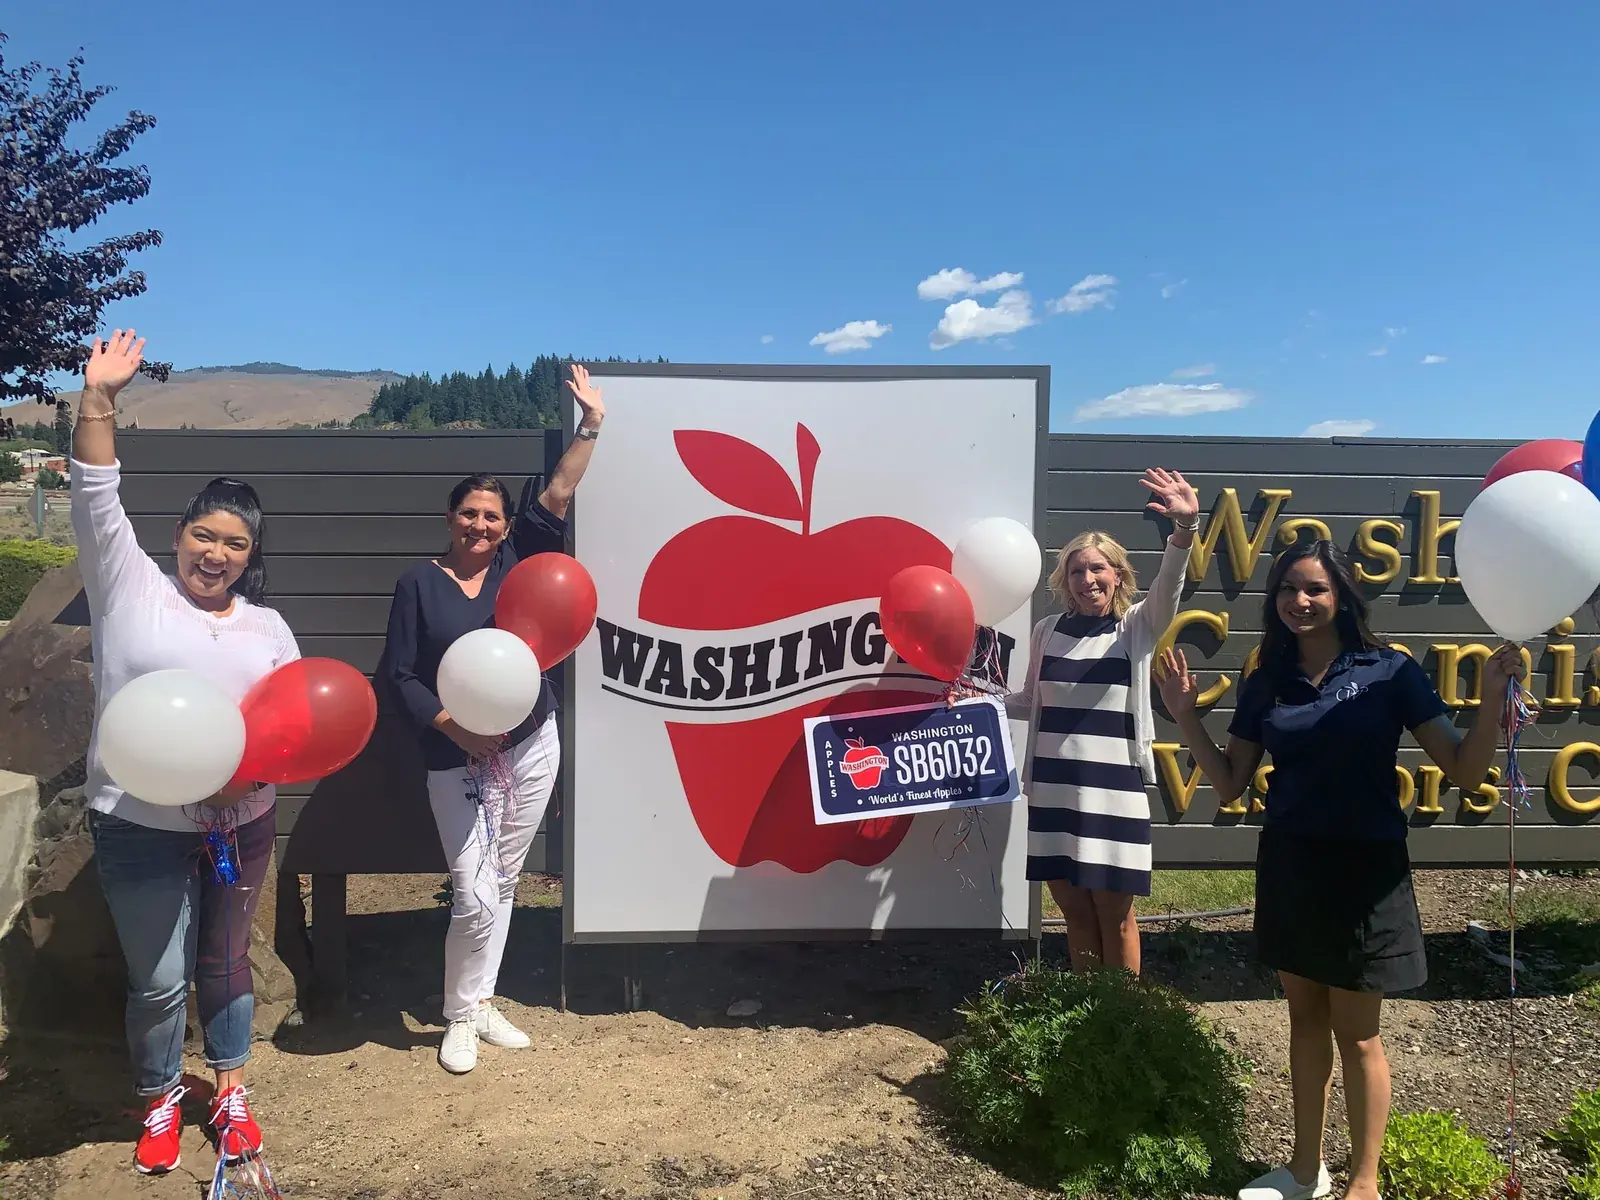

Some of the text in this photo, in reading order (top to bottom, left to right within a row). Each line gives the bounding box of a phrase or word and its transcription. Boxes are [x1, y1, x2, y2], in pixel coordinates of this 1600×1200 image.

[596, 610, 1015, 701] WASHINGN
[892, 723, 973, 742] WASHINGTON
[825, 740, 837, 798] APPLES
[840, 756, 888, 771] WASHINGTON
[893, 735, 996, 785] SB6032
[868, 787, 963, 805] World's Finest Apples
